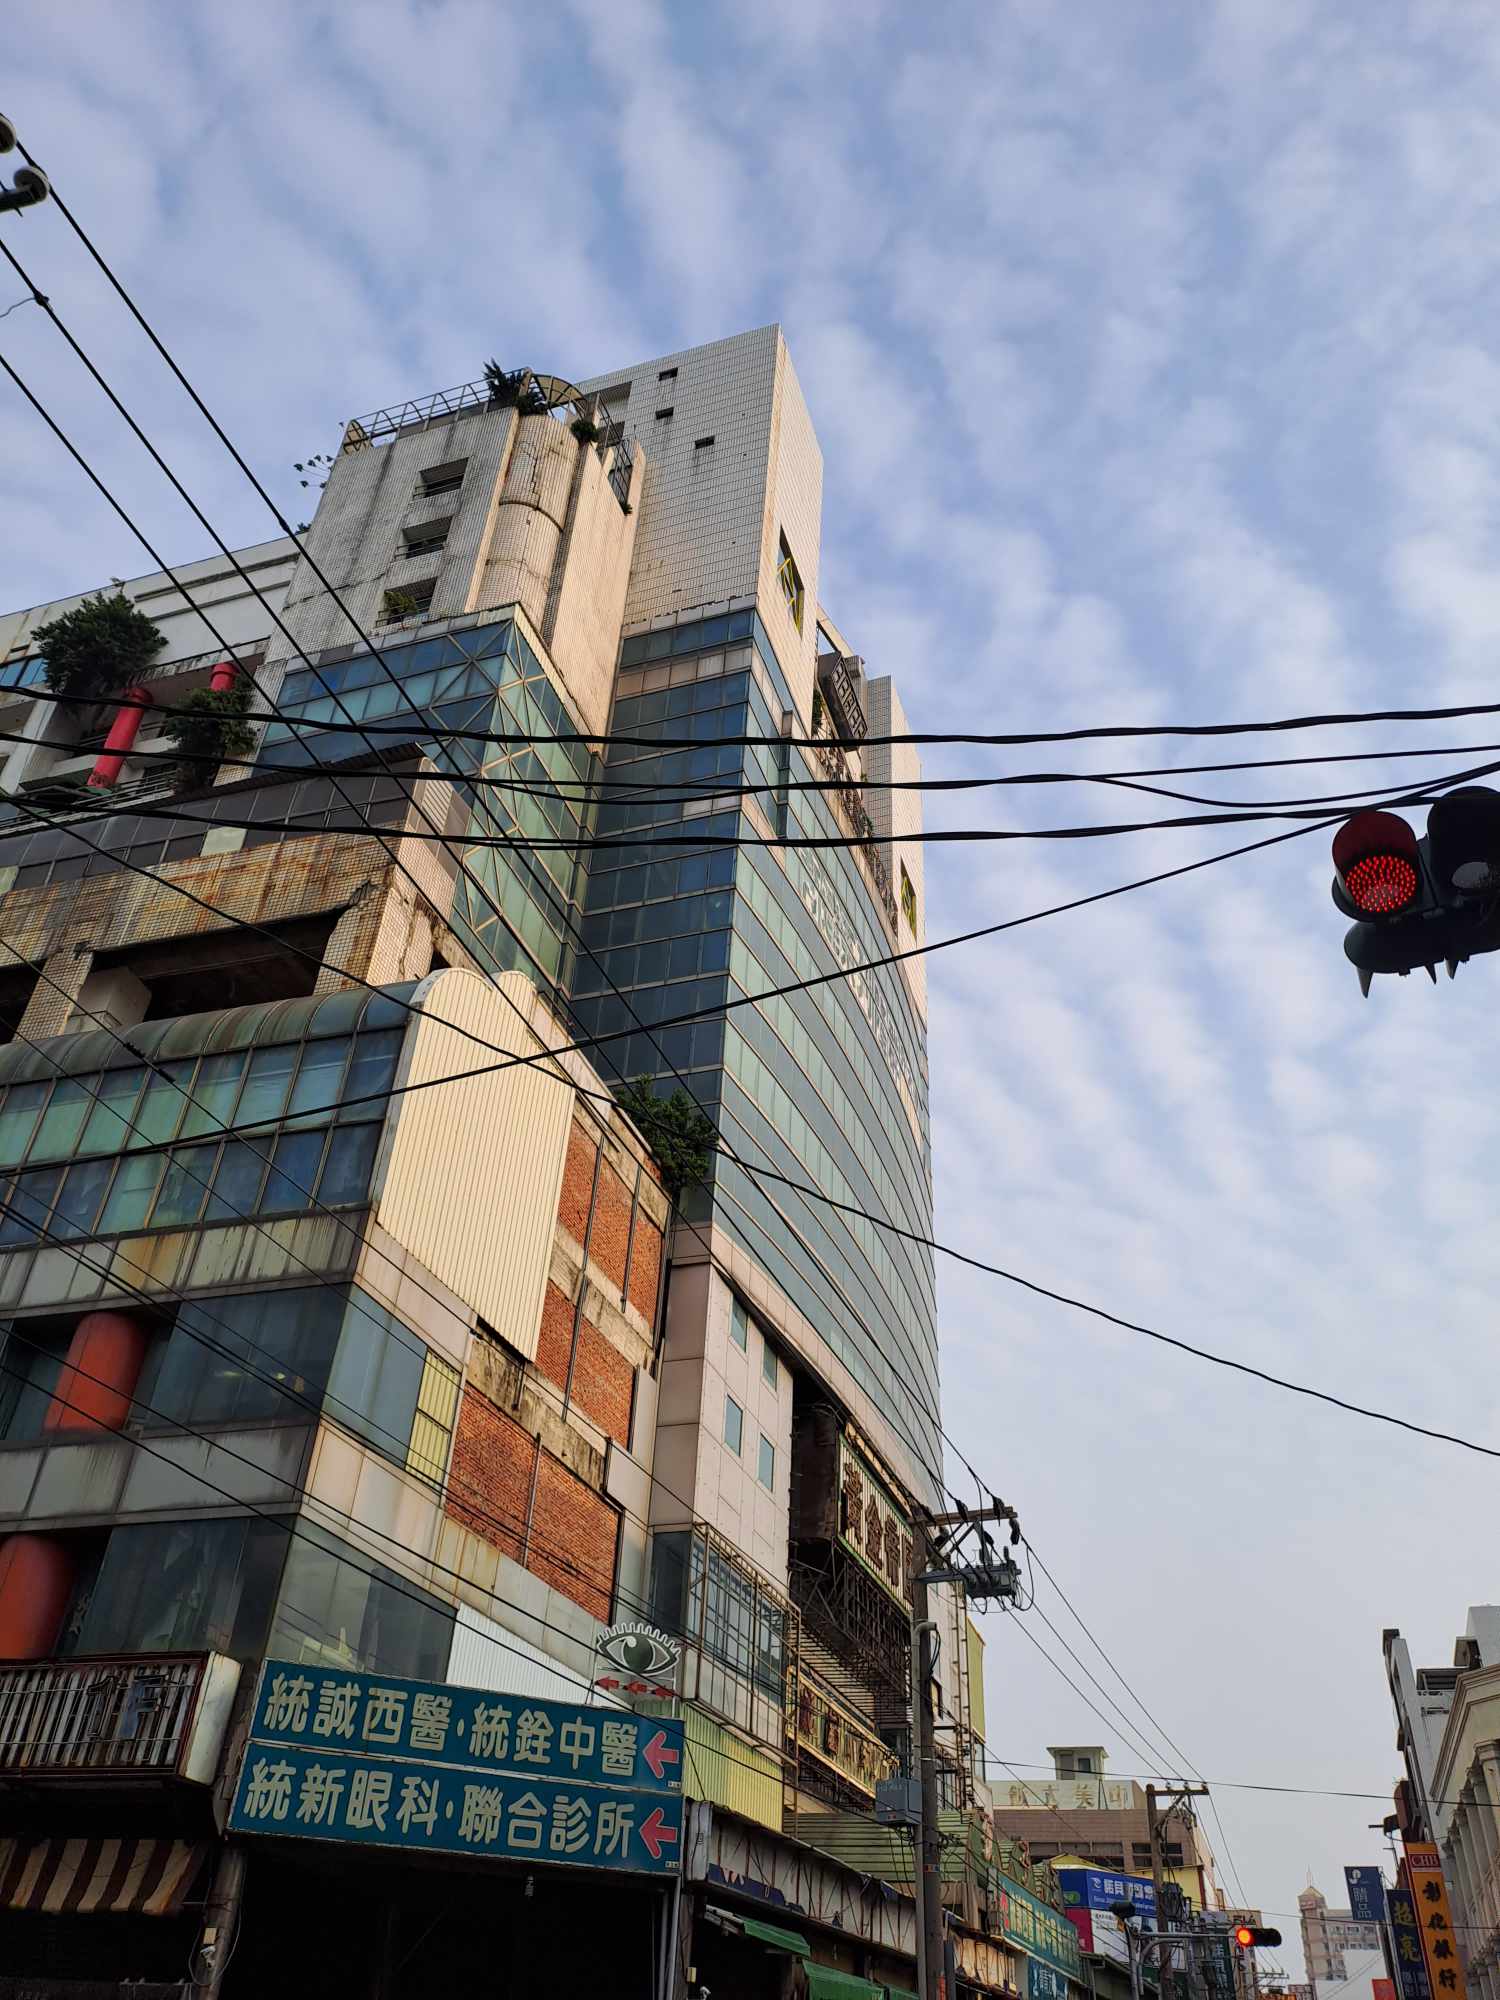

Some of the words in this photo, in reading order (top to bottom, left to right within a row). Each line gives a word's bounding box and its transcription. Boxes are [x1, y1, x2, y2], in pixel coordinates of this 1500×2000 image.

[1411, 1855, 1439, 1866] CHB
[1422, 1880, 1457, 1991] 彰化銀行
